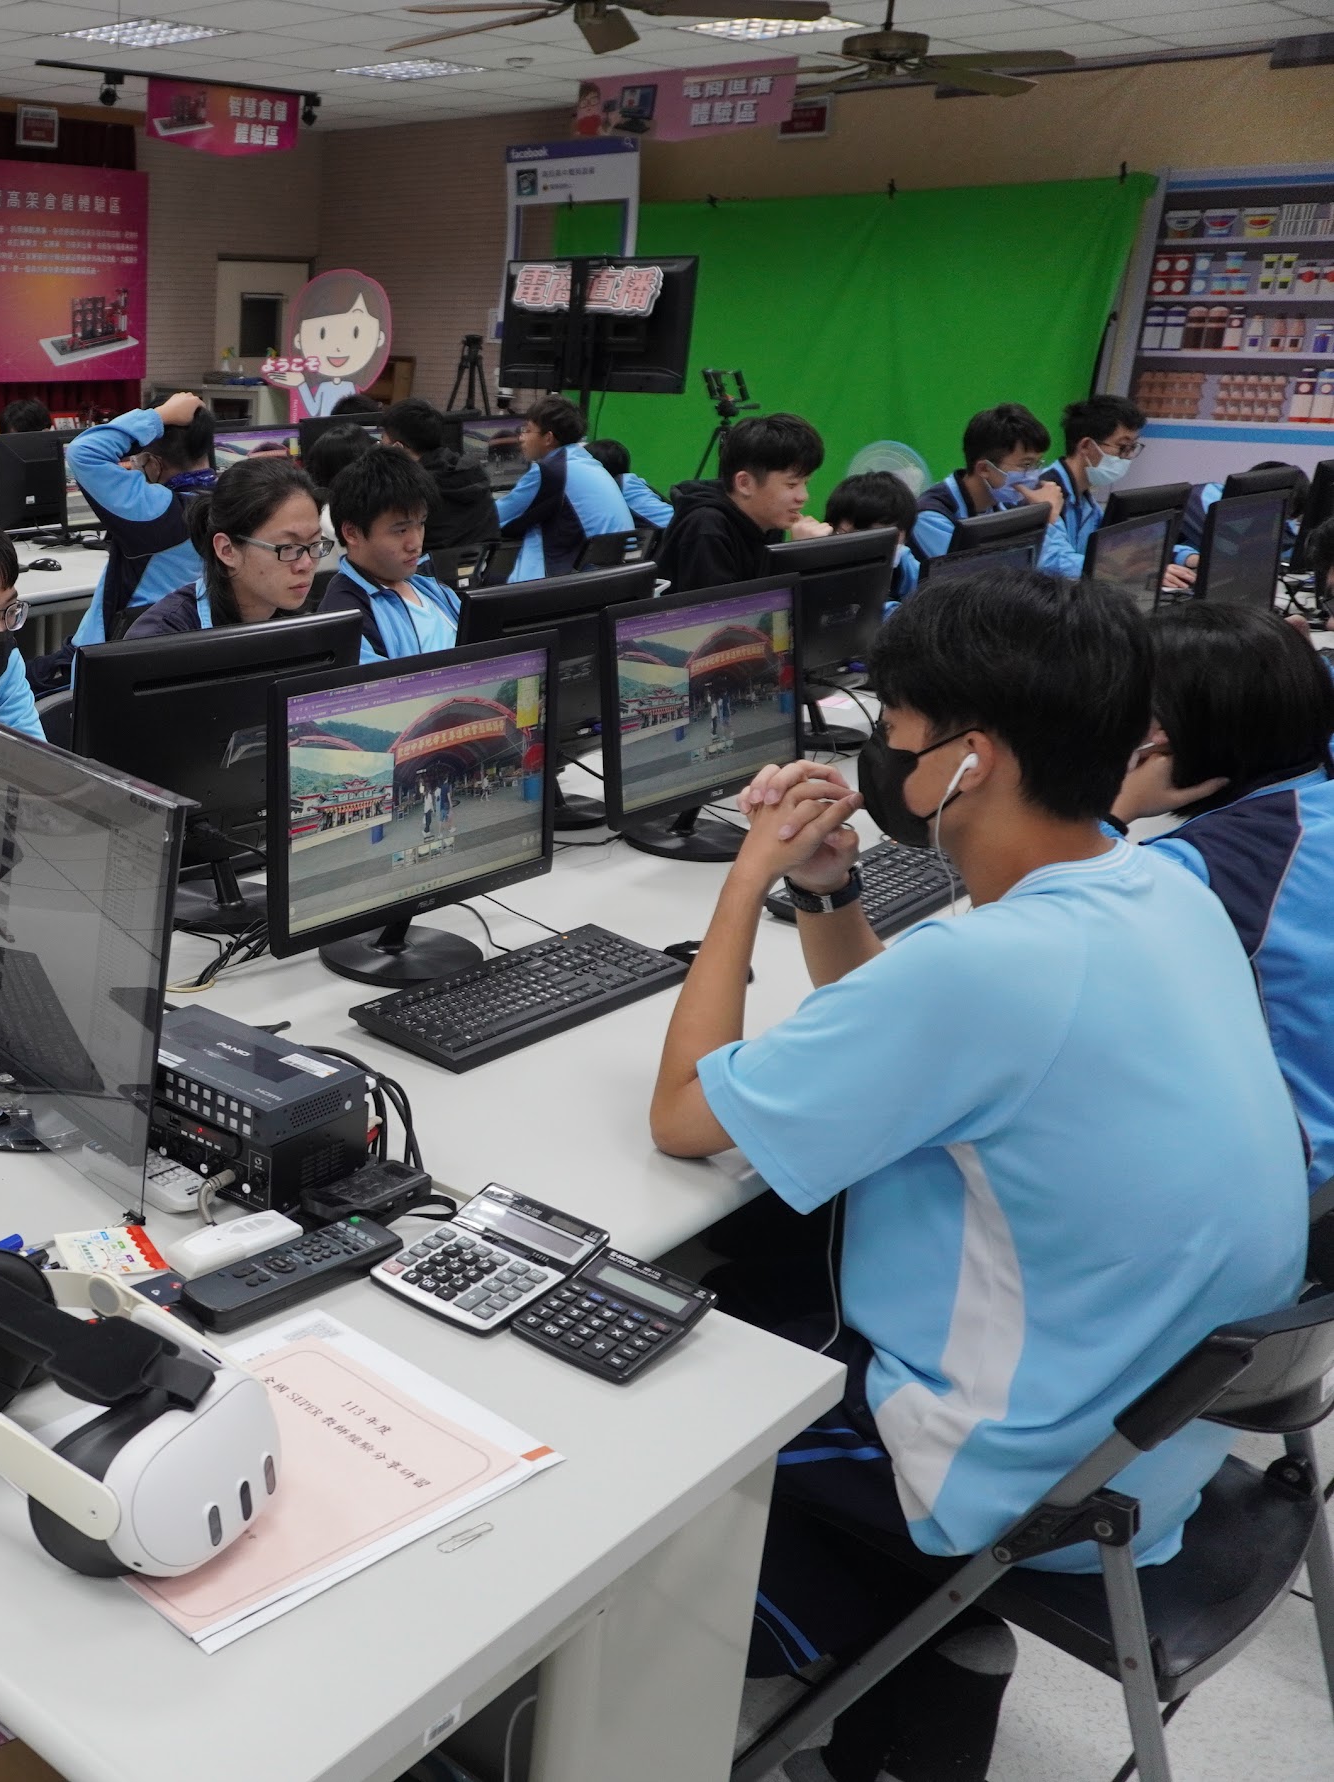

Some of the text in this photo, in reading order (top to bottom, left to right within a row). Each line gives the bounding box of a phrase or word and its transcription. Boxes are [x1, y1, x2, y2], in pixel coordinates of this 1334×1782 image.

[682, 76, 774, 99] 電商直播
[690, 100, 758, 127] 體驗區
[234, 122, 279, 146] 體驗區
[511, 145, 549, 160] facebook
[261, 356, 320, 372] ようこそ
[417, 898, 435, 909] ASUS
[609, 1251, 638, 1266] E-MORE
[531, 1270, 543, 1278] GT
[423, 1279, 436, 1287] 00
[545, 1325, 558, 1334] 00
[341, 1400, 393, 1436] 113 年度
[261, 1375, 432, 1489] 全國 SUPER 教師經驗分享研習
